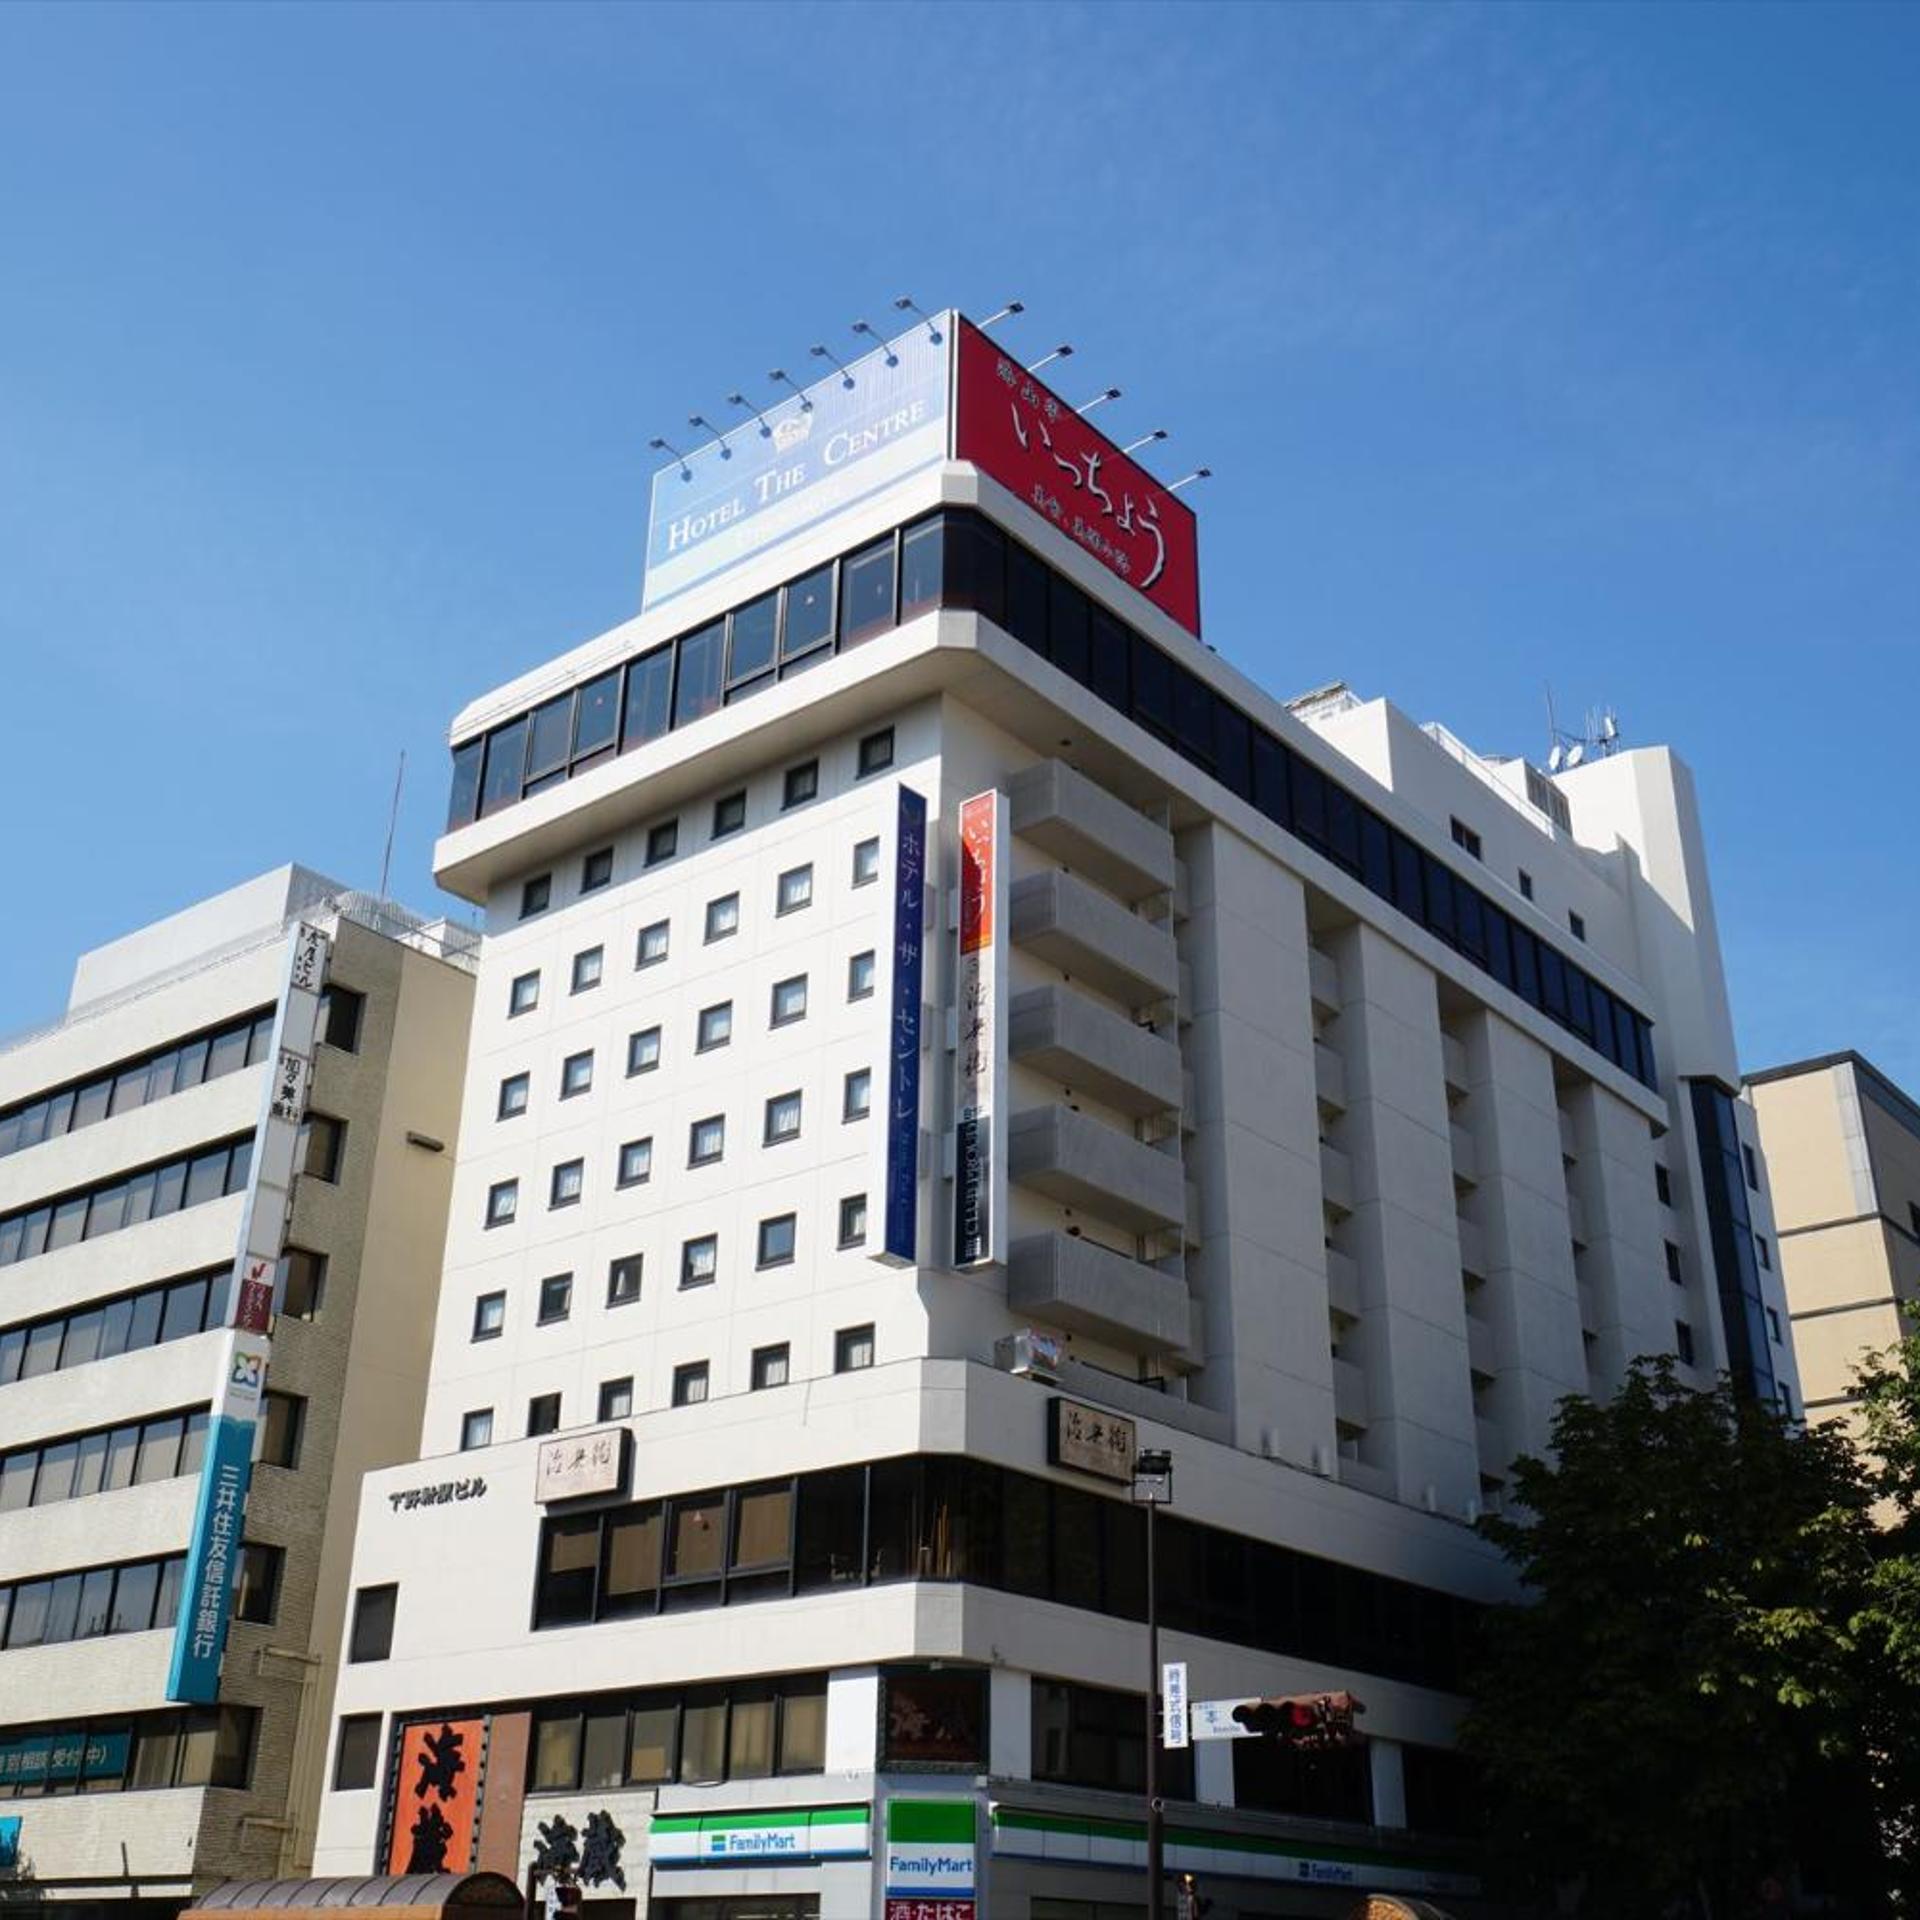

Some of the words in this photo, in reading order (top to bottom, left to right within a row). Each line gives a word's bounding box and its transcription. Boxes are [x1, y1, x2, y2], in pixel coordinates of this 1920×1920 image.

[668, 497, 745, 551] HOTEL
[754, 464, 806, 502] THE
[823, 399, 924, 466] CENTRE
[1011, 401, 1166, 589] いっちょう
[896, 834, 921, 1119] ホテル・ザ・セントレ
[194, 1464, 240, 1659] 三井住友信託銀行
[729, 1833, 796, 1852] FamilyMart
[890, 1857, 972, 1877] FamilyMart
